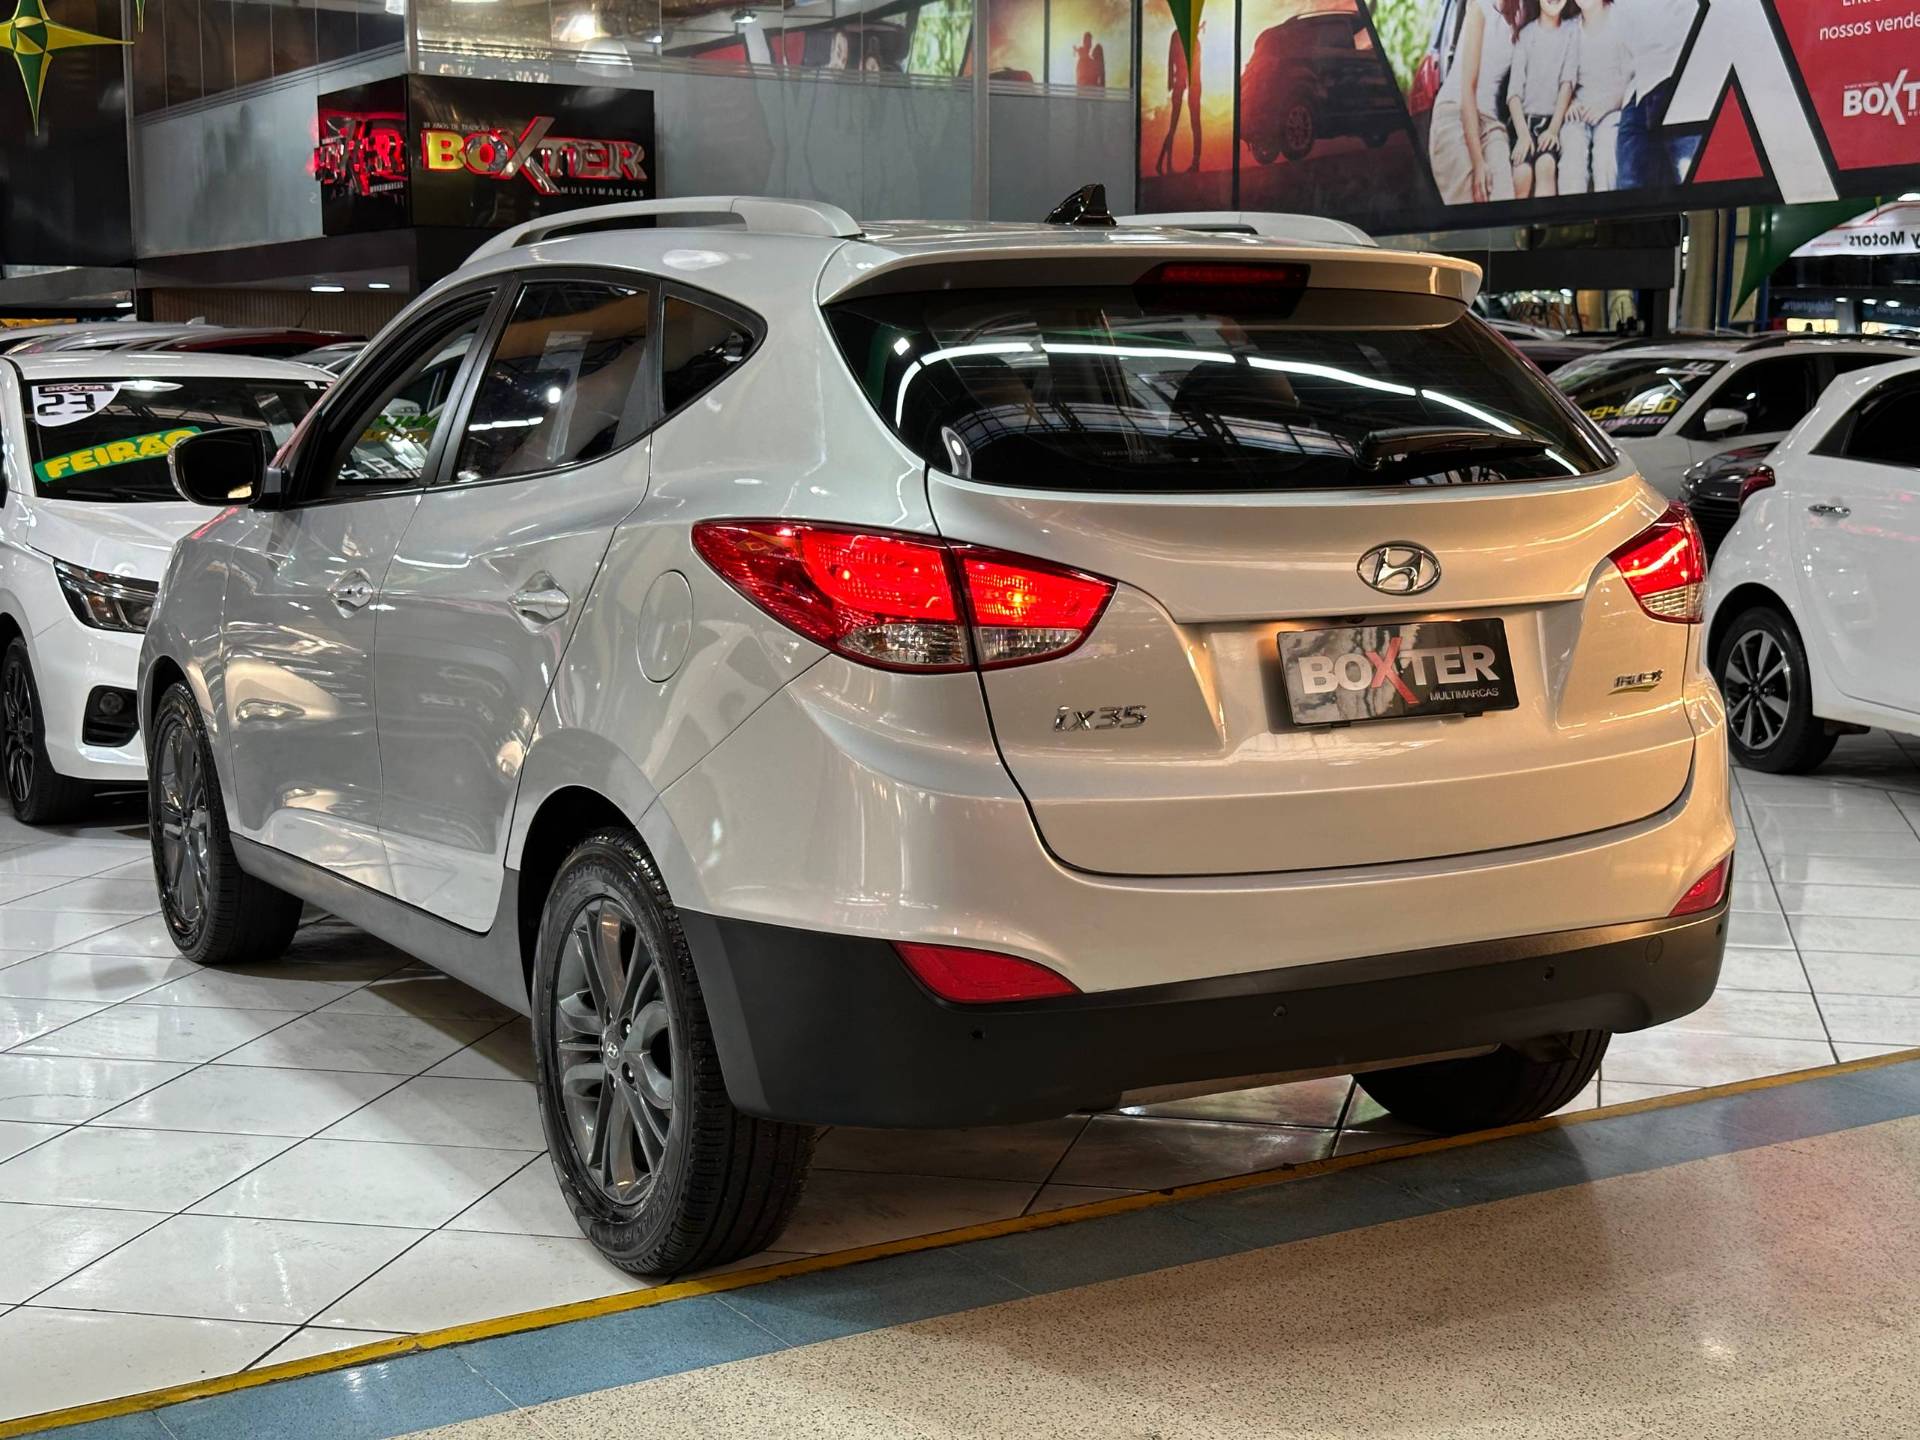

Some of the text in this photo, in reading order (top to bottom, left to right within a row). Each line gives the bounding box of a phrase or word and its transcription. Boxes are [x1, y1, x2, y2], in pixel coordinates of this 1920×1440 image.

[1820, 21, 1871, 40] nossos
[420, 116, 648, 196] BOXTER
[560, 186, 645, 197] MULTIMARCAS
[45, 384, 105, 392] BOXTER
[37, 392, 96, 416] 23
[1299, 637, 1500, 704] BOXTER
[1430, 687, 1499, 701] MULTIMARCAS
